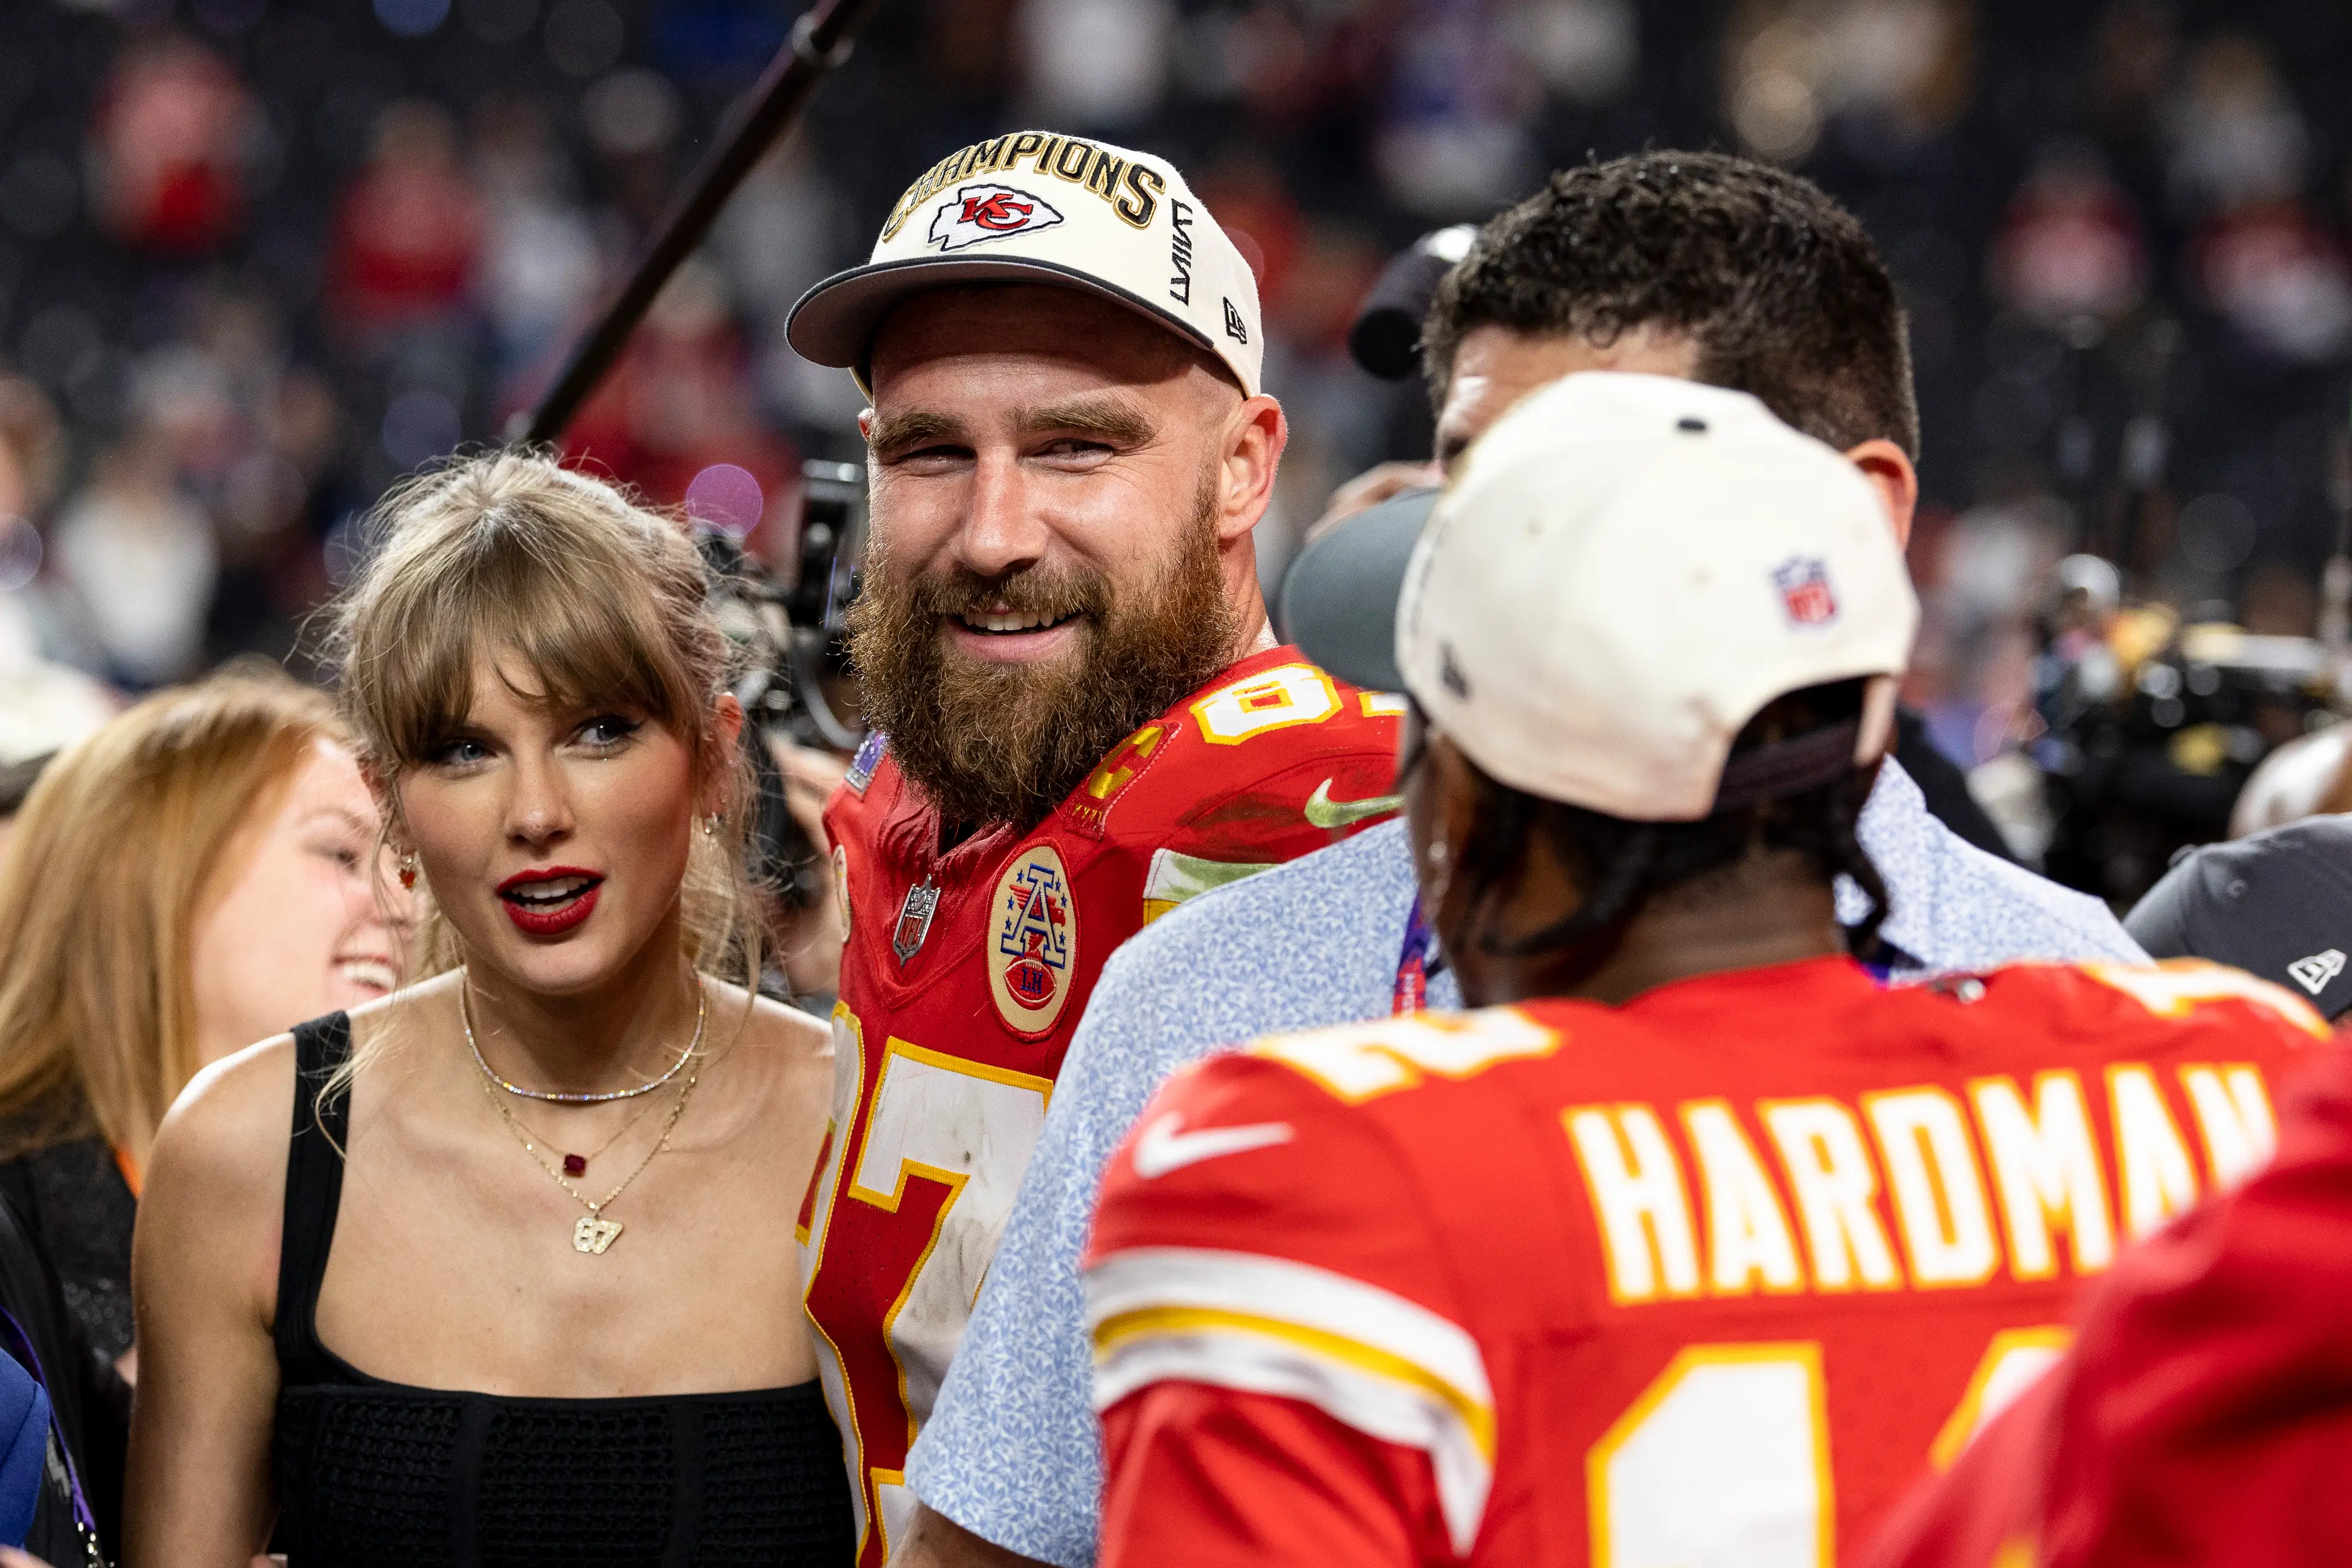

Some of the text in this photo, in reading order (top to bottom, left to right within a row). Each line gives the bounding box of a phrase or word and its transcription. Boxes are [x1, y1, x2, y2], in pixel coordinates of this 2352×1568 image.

[882, 130, 1166, 243] CHAMPIONS
[957, 193, 1035, 230] KC
[1020, 968, 1043, 994] LH
[1560, 1061, 2280, 1306] HARDMAN
[573, 1217, 624, 1254] 87
